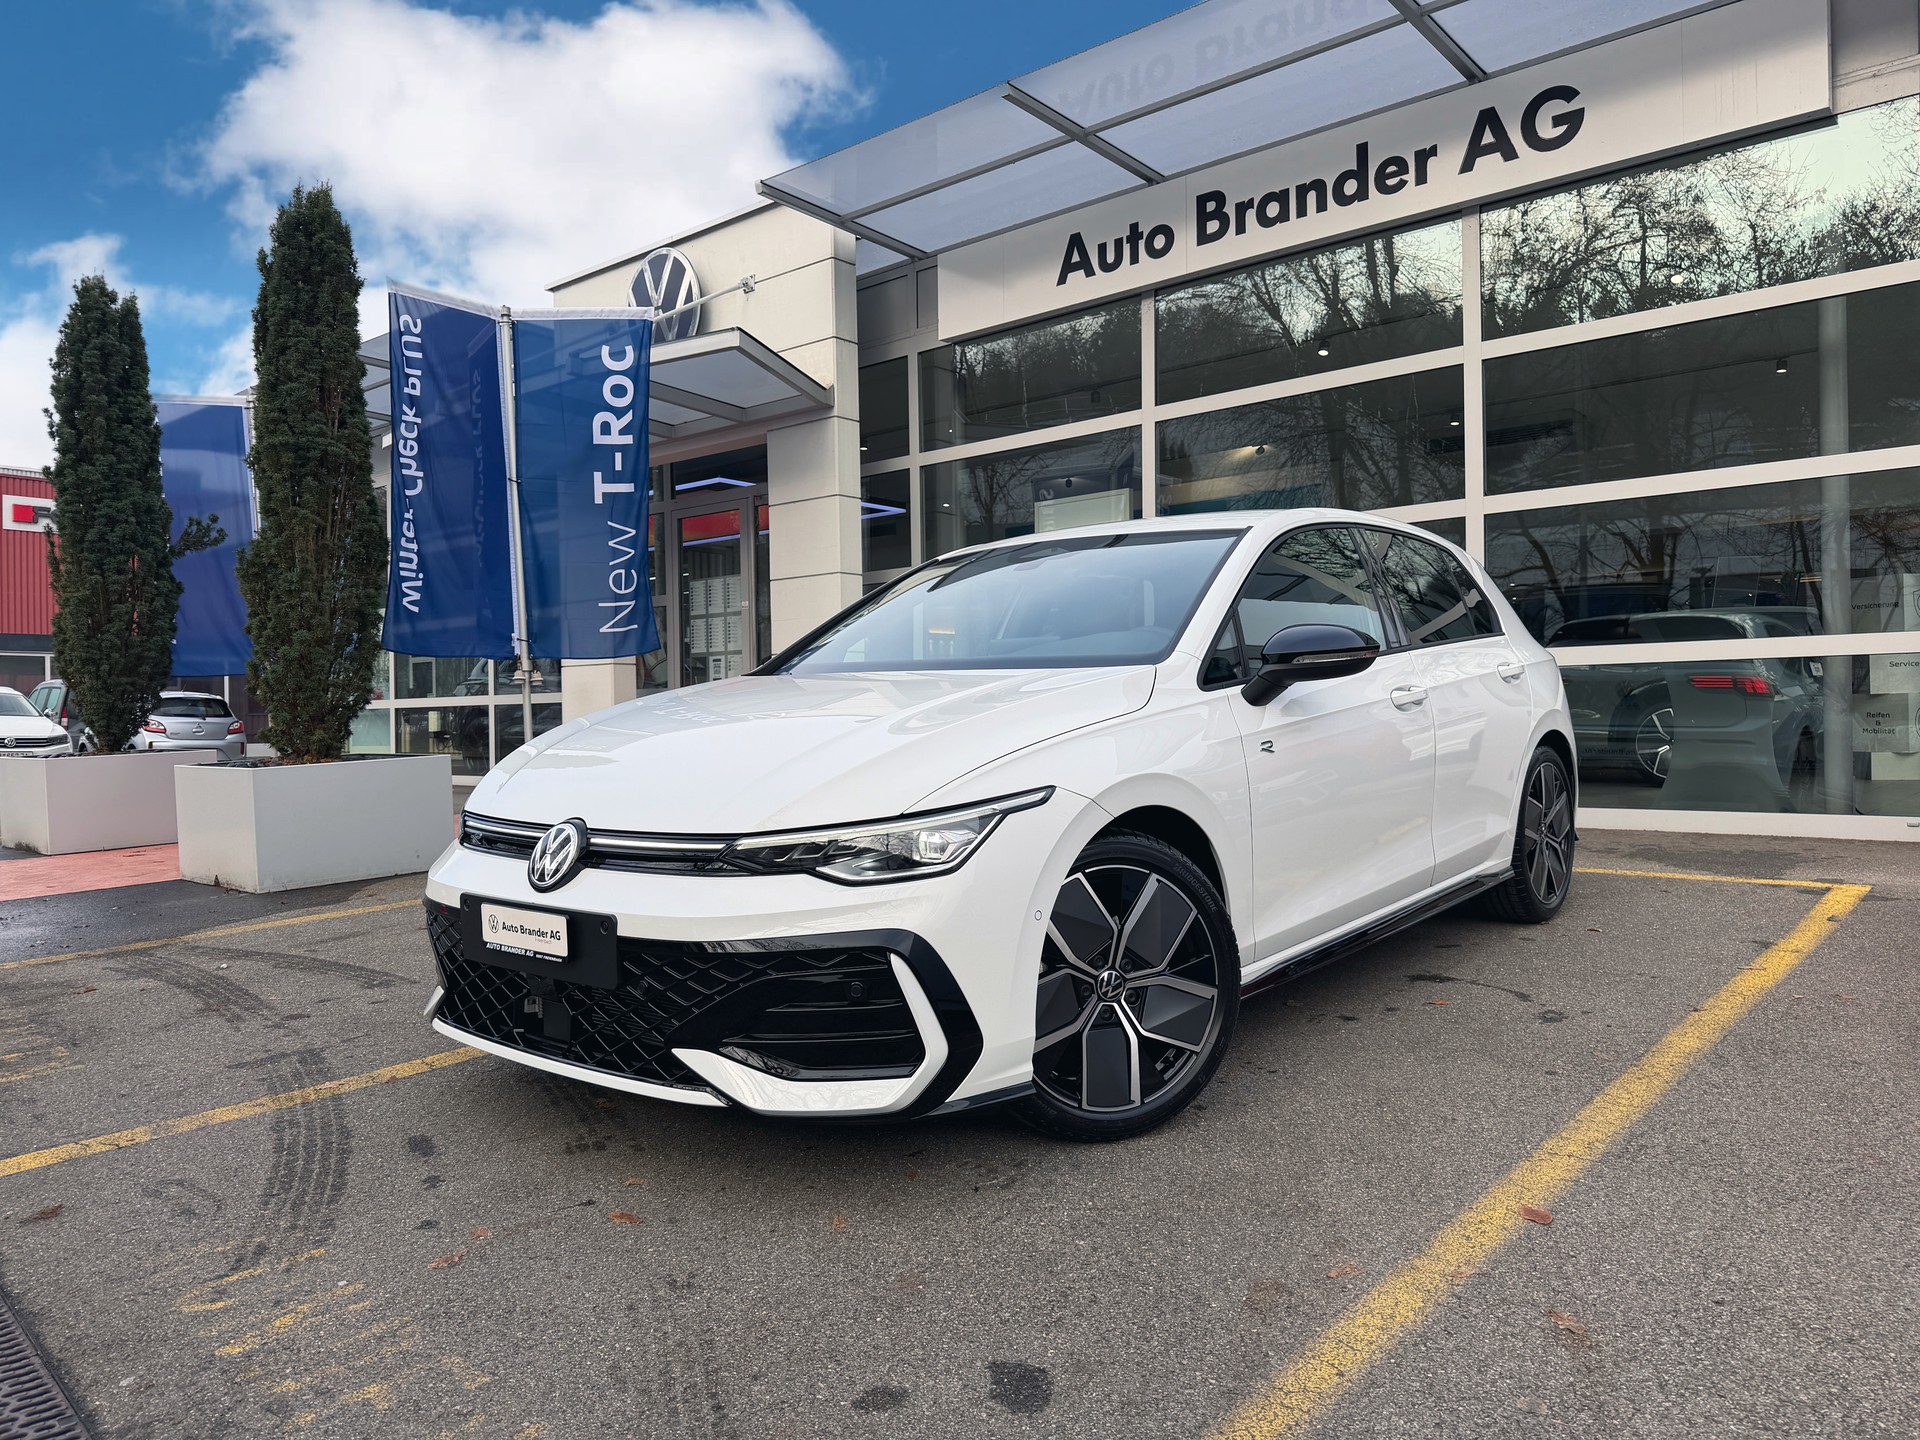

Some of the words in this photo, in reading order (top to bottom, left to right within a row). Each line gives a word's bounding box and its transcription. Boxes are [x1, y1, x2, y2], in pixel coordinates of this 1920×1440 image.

[1056, 221, 1175, 287] Auto
[1195, 140, 1438, 247] Brander
[1457, 84, 1586, 175] AG
[592, 344, 636, 505] T-Roc
[597, 520, 639, 633] New
[1851, 601, 1899, 611] Versicherung
[1889, 660, 1920, 668] Service
[1866, 711, 1890, 719] Reifen
[502, 921, 518, 933] Auto
[520, 925, 548, 938] Brander
[550, 930, 561, 940] AG
[501, 945, 526, 955] BRANDER
